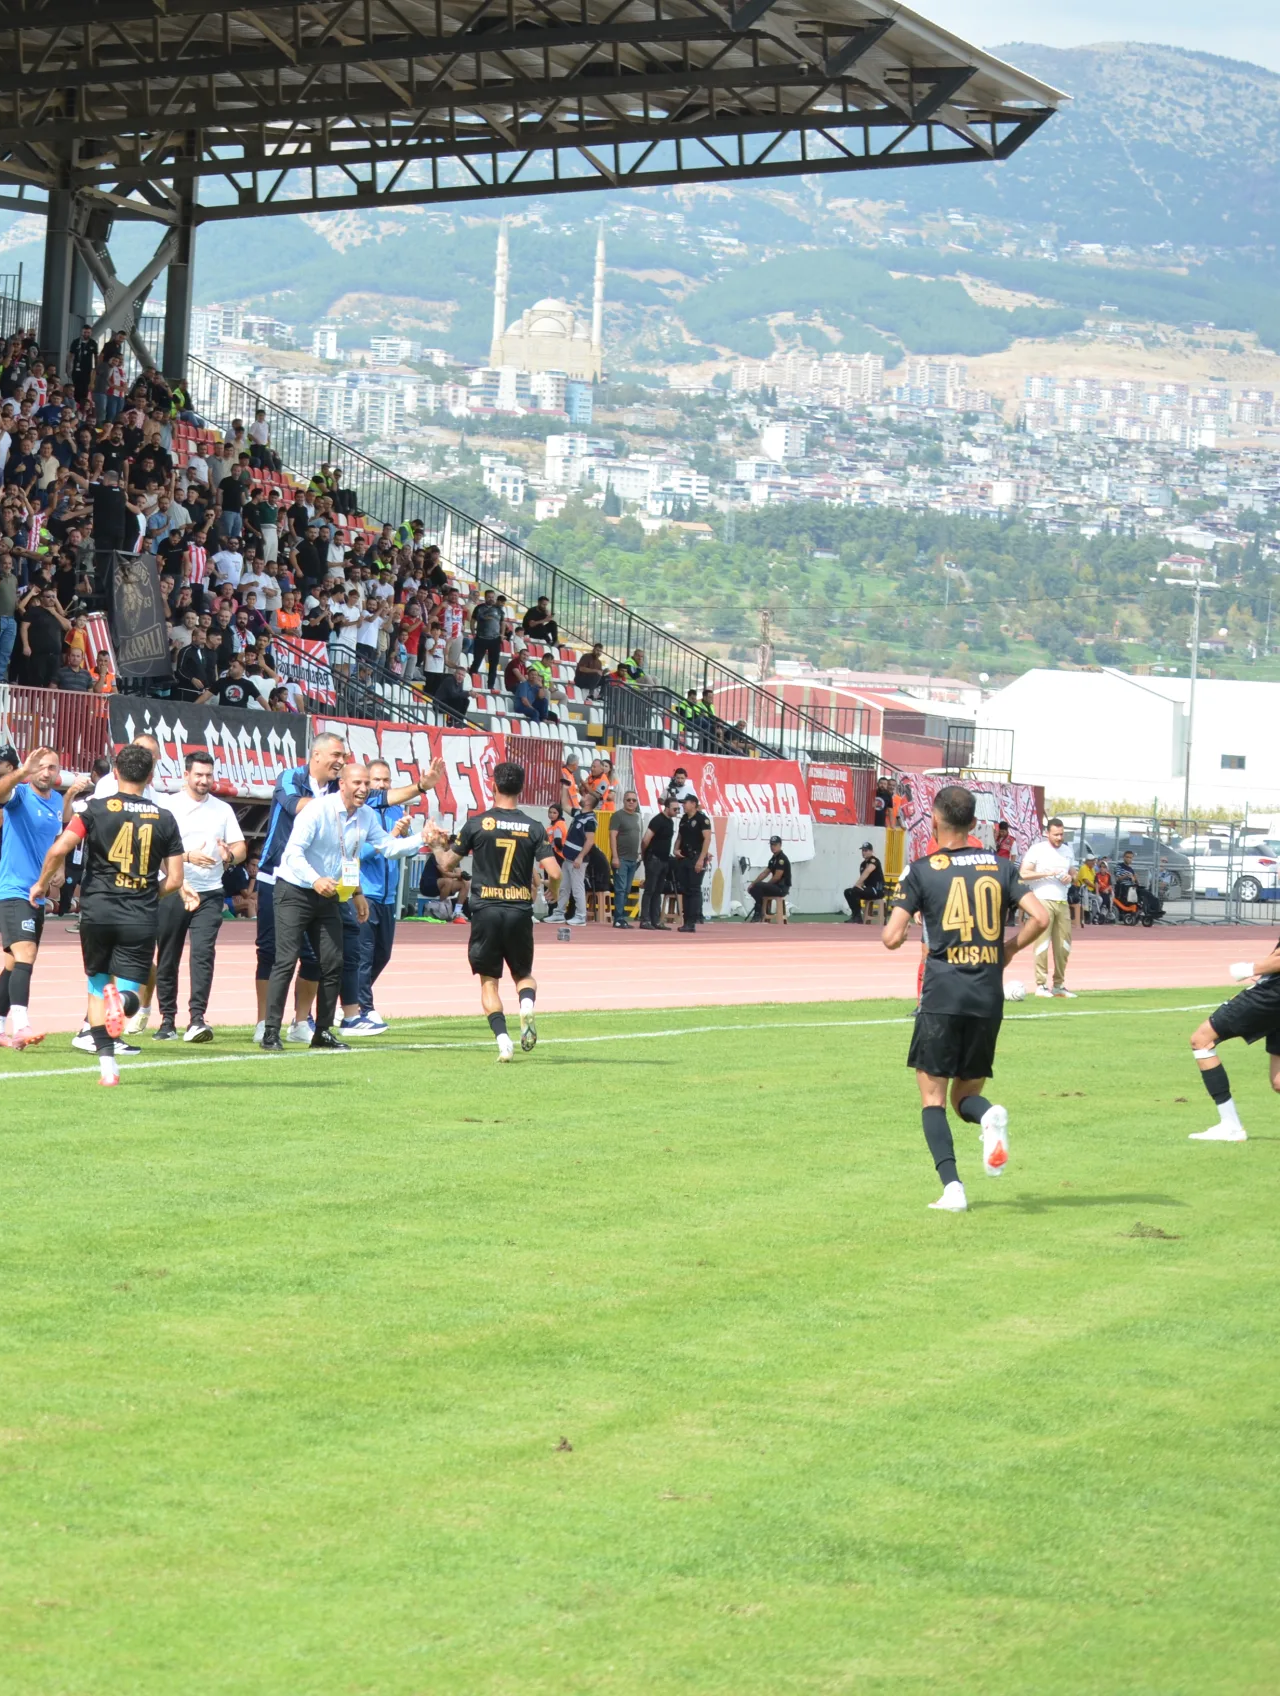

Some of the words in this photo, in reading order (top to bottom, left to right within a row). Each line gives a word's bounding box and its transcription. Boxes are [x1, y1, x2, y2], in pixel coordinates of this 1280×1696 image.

[108, 821, 153, 875] 41
[496, 838, 517, 884] 7
[942, 875, 1002, 942] 40
[947, 945, 999, 966] KUŞAN
